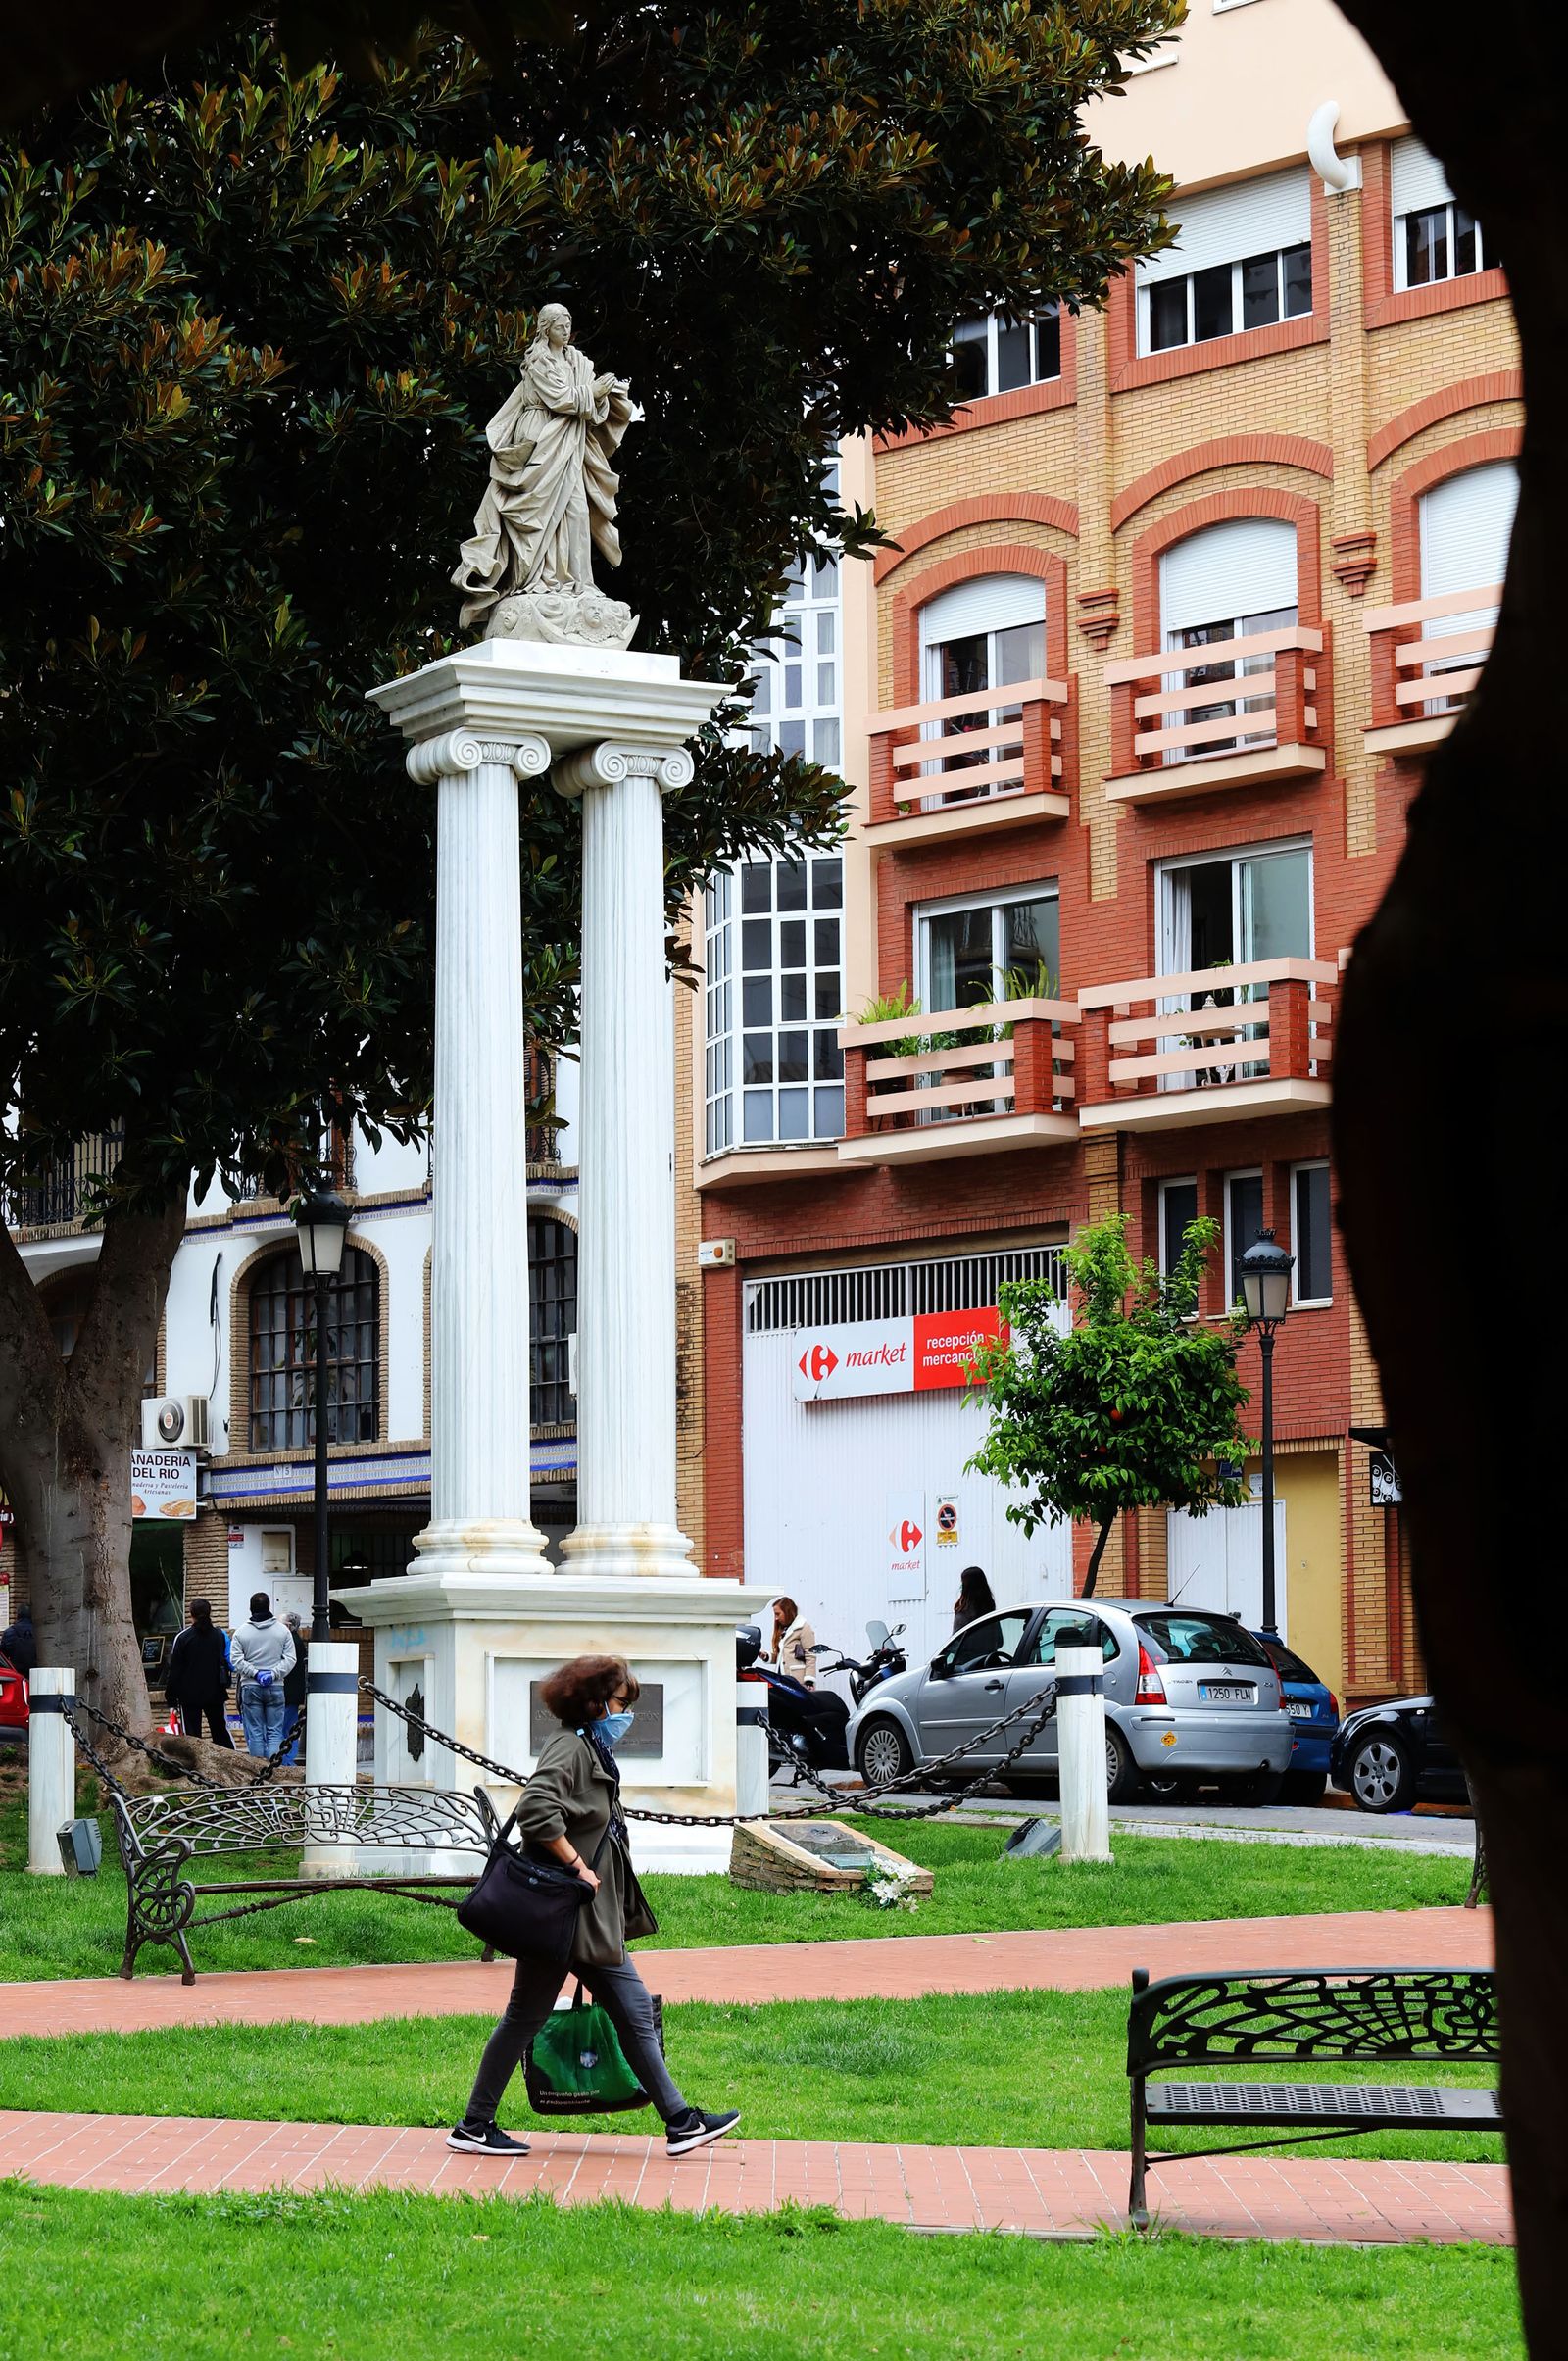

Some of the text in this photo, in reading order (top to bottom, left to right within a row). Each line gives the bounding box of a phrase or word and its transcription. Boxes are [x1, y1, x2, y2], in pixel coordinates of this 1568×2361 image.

[927, 1330, 985, 1350] recepción
[846, 1342, 907, 1367] market
[131, 1454, 191, 1467] ANADERIA
[132, 1467, 180, 1480] DEL RIO
[891, 1559, 921, 1571] market
[1208, 1687, 1231, 1699] 1250
